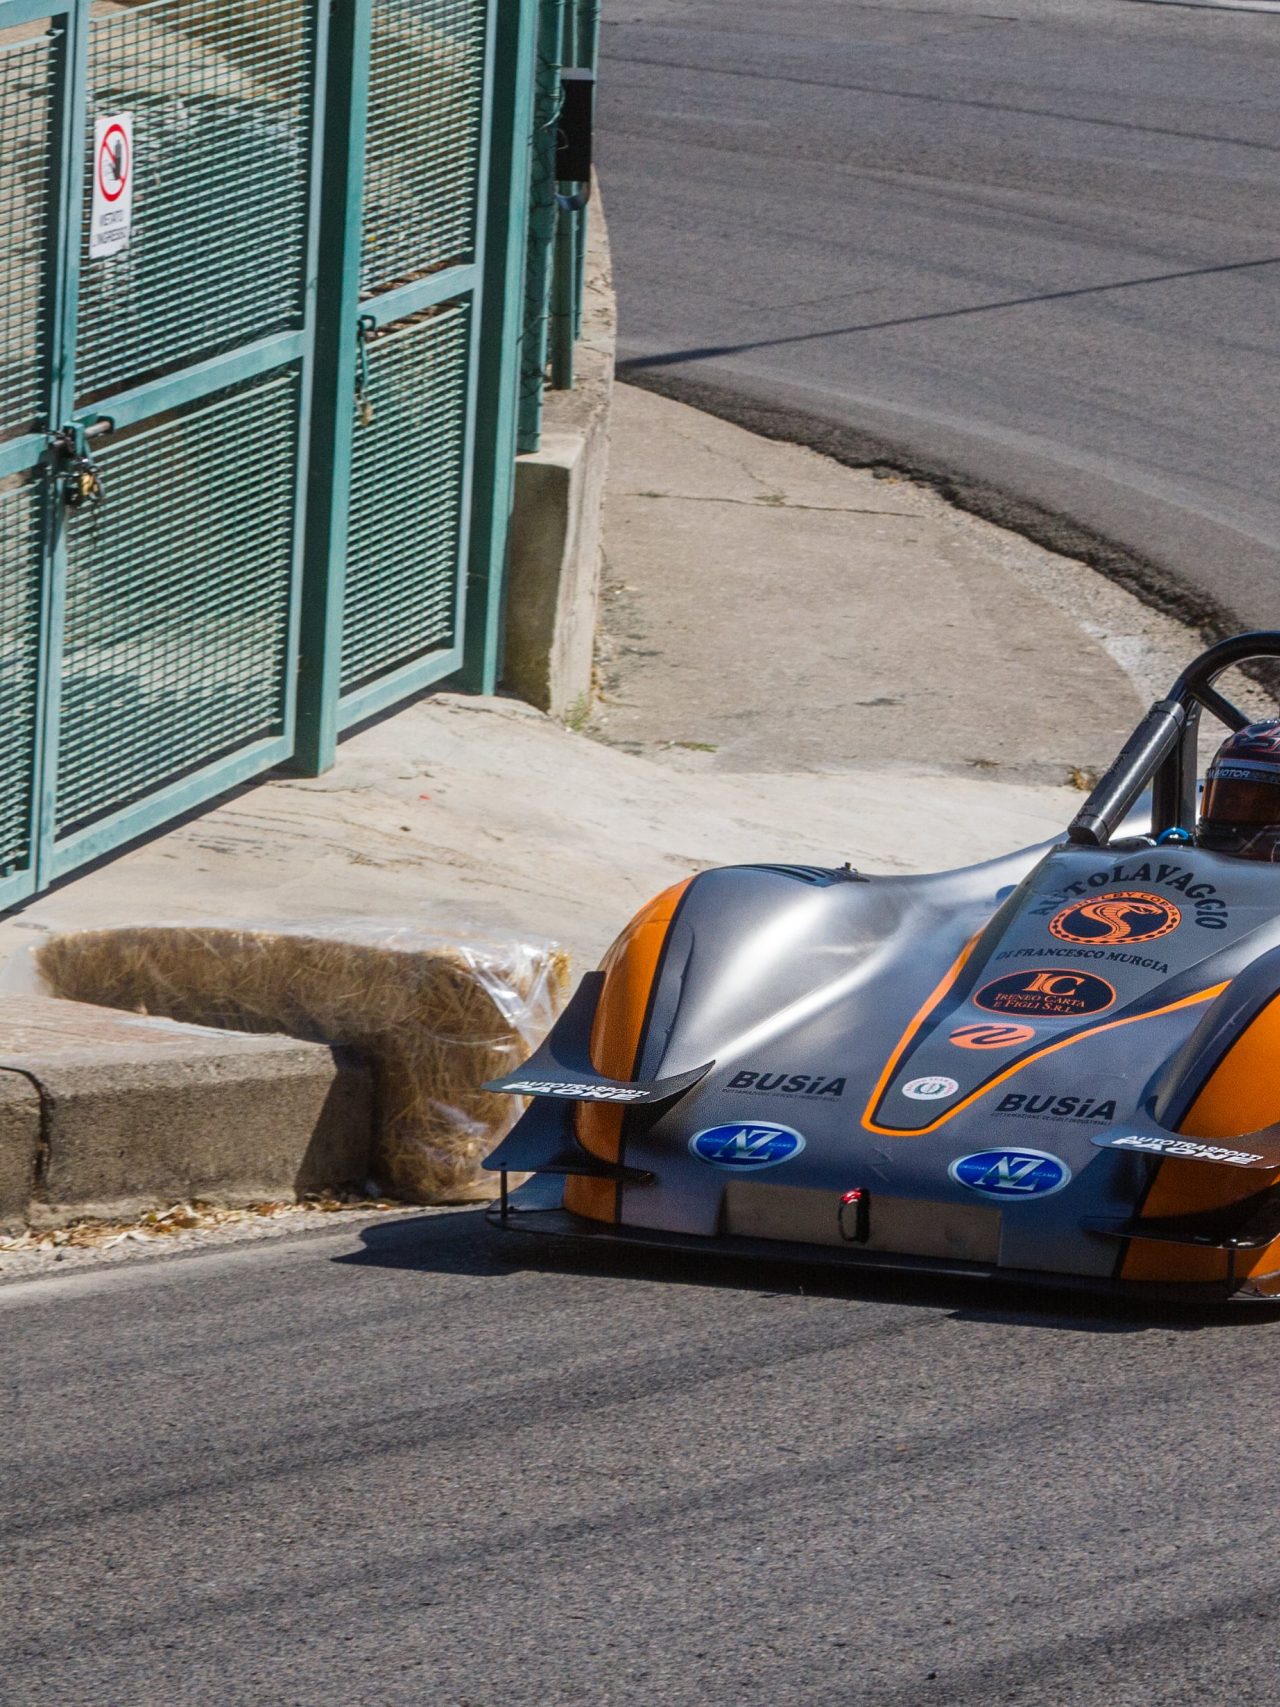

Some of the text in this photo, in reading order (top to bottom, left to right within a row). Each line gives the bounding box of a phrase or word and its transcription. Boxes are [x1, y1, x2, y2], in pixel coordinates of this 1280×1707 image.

[1028, 862, 1229, 930] AUTOLAVAGGIO
[996, 947, 1169, 974] DI FRANCESCO MURGIA
[1023, 973, 1085, 996] IC
[994, 993, 1085, 1009] IRENEO CARTA
[1006, 999, 1041, 1009] FIGLI
[502, 1083, 641, 1100] PAONE
[514, 1081, 650, 1096] AUTOTRASPORTI
[1112, 1138, 1251, 1164] PAONE
[1124, 1135, 1264, 1162] AUTOTRASPORTI
